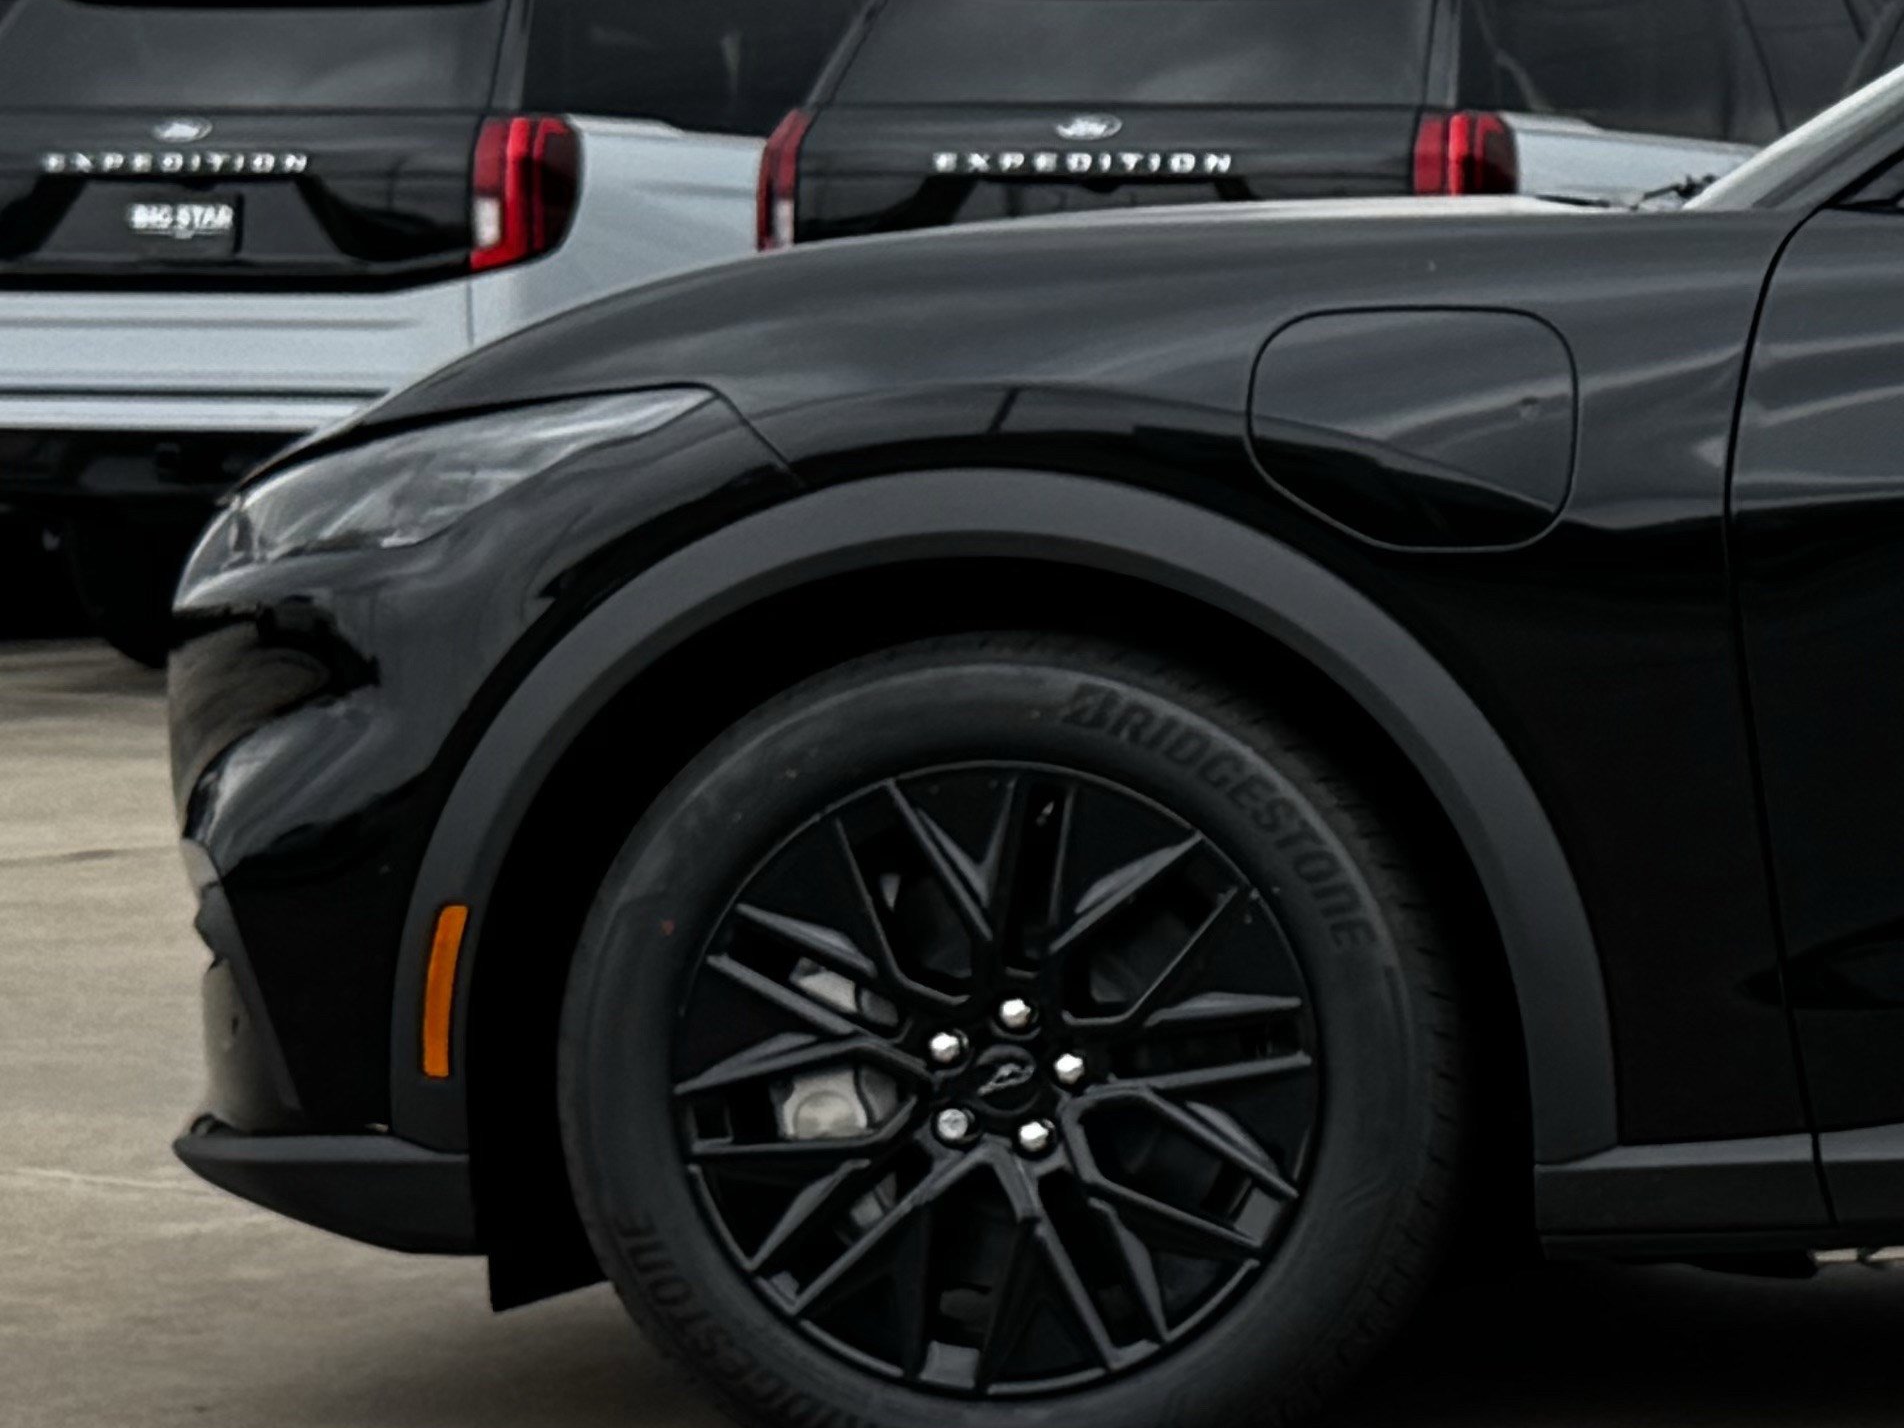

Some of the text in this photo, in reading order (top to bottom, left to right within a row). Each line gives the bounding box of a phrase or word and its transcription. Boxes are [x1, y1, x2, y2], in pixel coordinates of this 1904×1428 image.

[43, 151, 308, 173] EXPEDITION
[932, 151, 1232, 173] EXPEDITION
[1062, 683, 1377, 947] BRIDGESTONE
